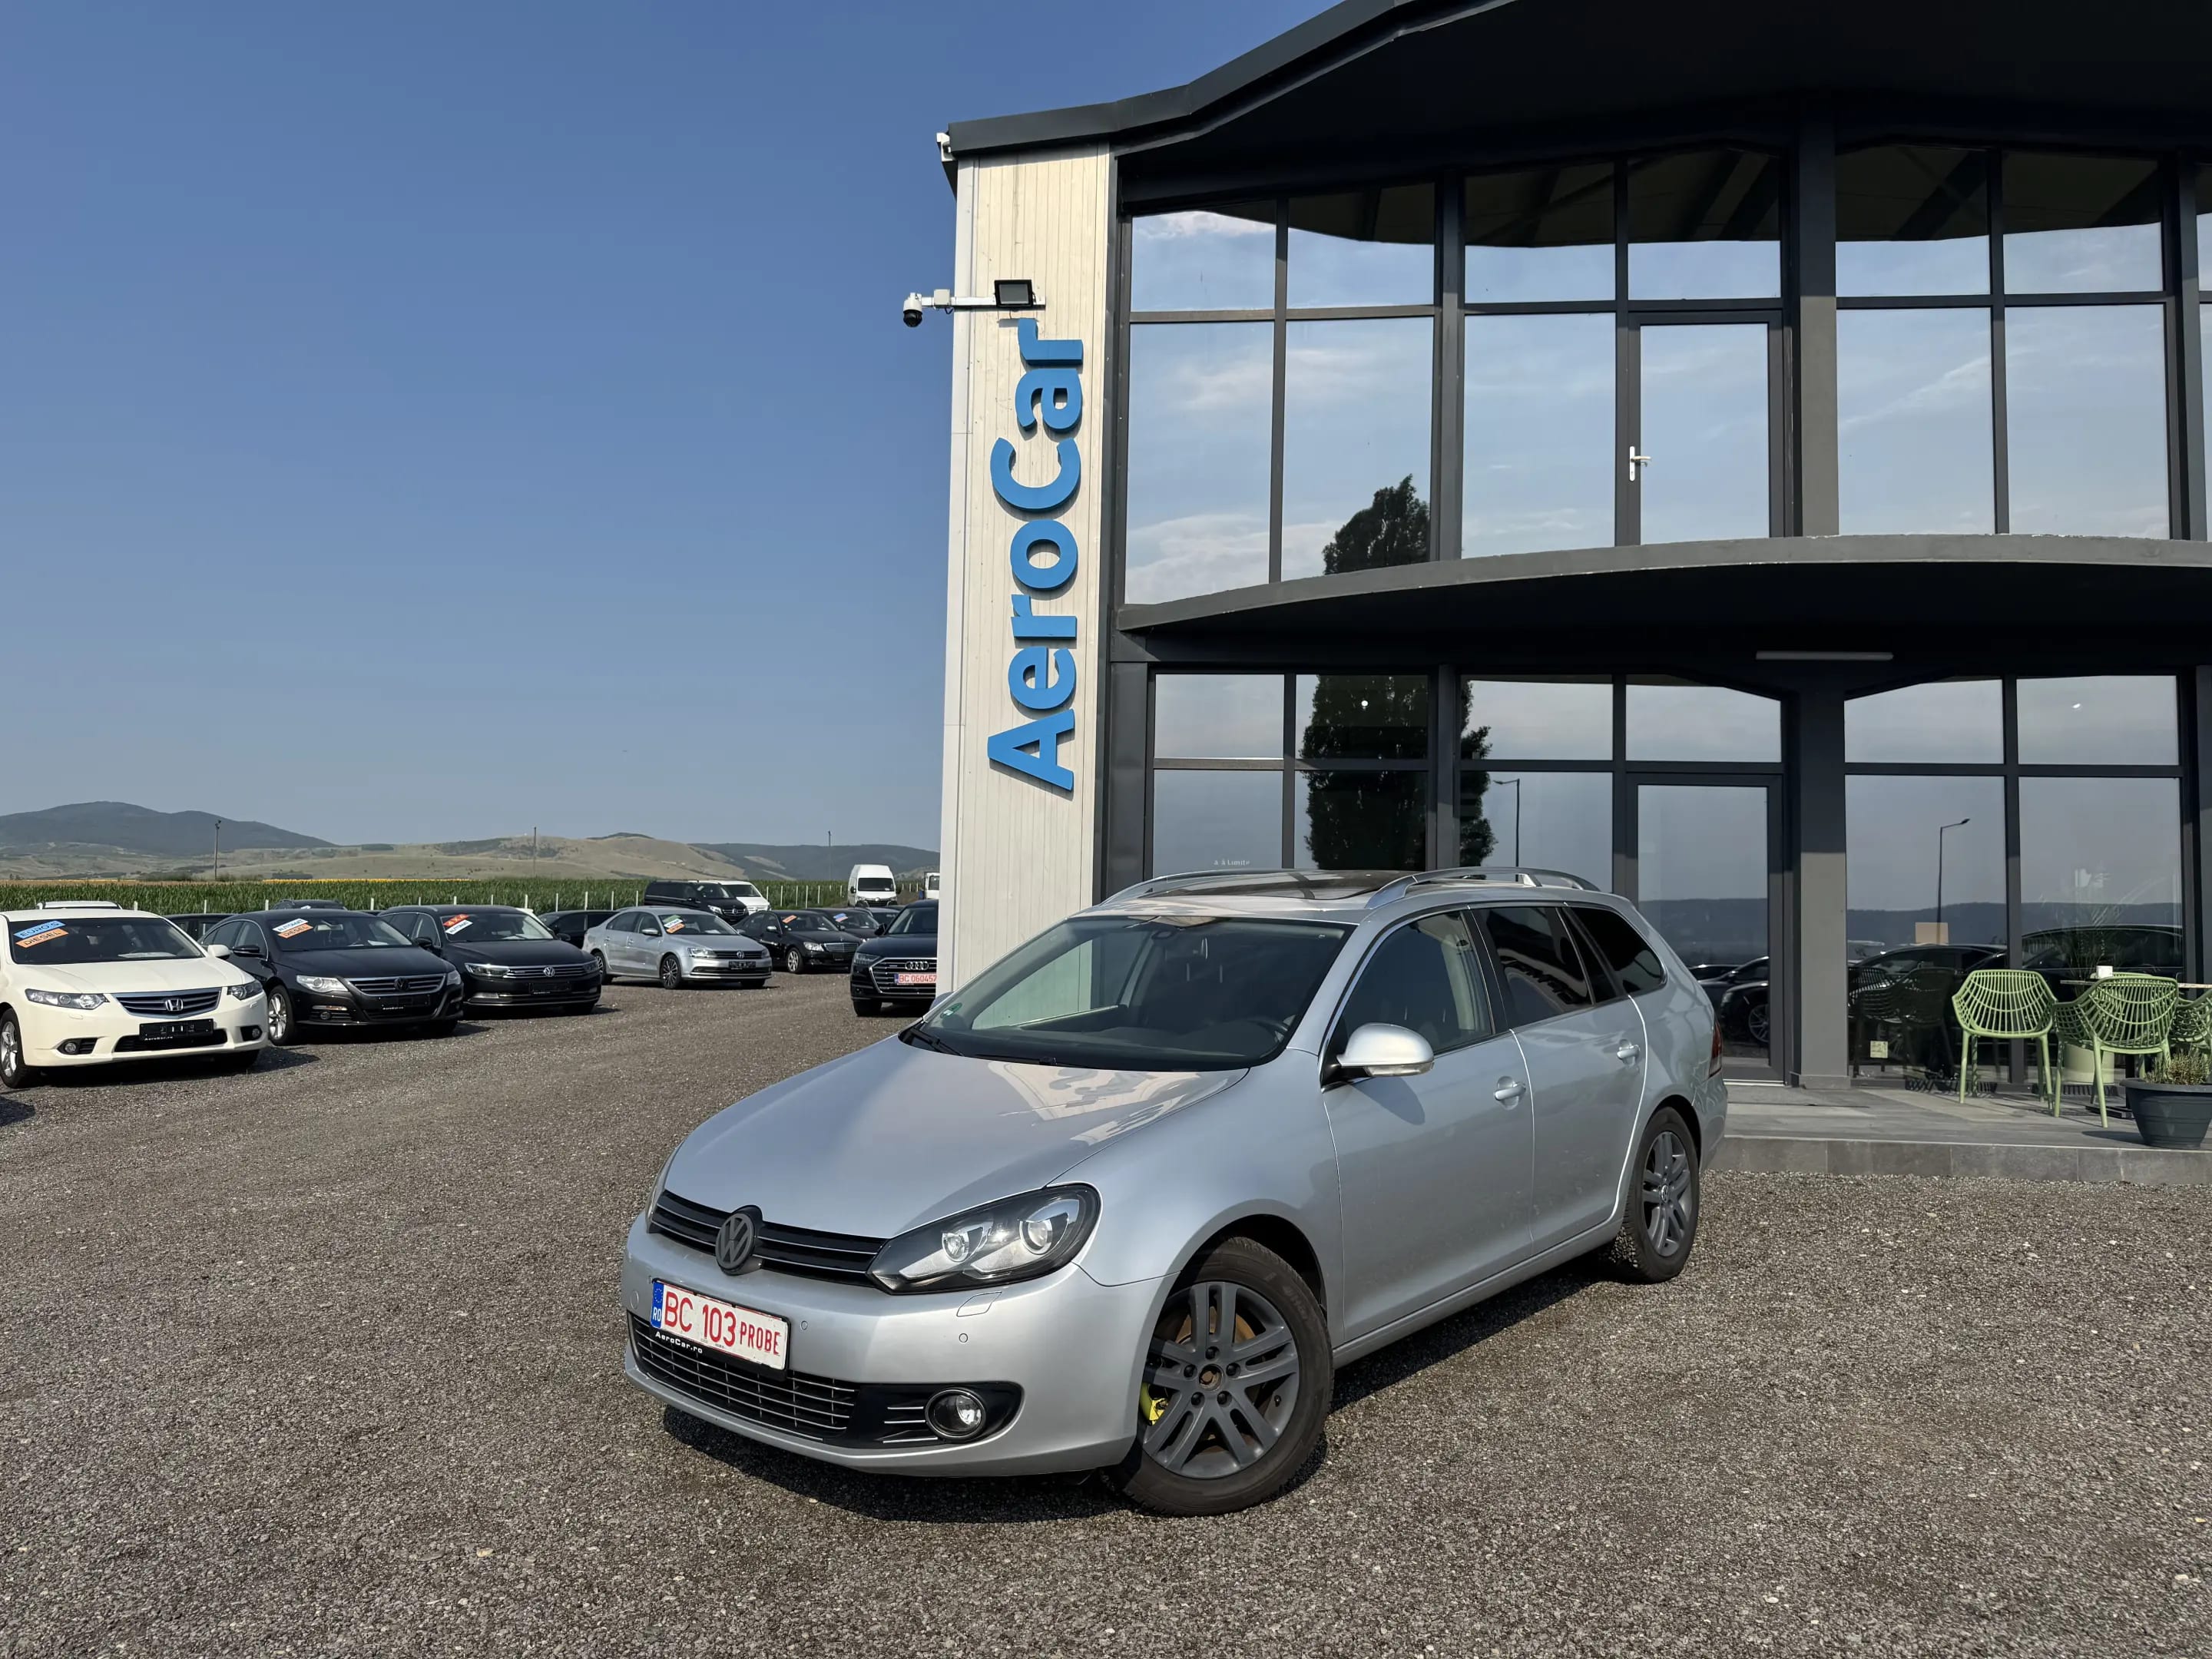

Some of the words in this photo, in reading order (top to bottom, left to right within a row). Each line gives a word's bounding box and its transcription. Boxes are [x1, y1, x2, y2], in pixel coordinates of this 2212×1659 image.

[987, 318, 1084, 791] AeroCar
[20, 925, 50, 937] EURO
[23, 929, 62, 945] DIESEL
[652, 1306, 662, 1323] RO
[664, 1291, 694, 1333] BC
[702, 1303, 737, 1347] 103
[740, 1321, 782, 1356] PROBE
[654, 1330, 704, 1354] AeroCar.ro
